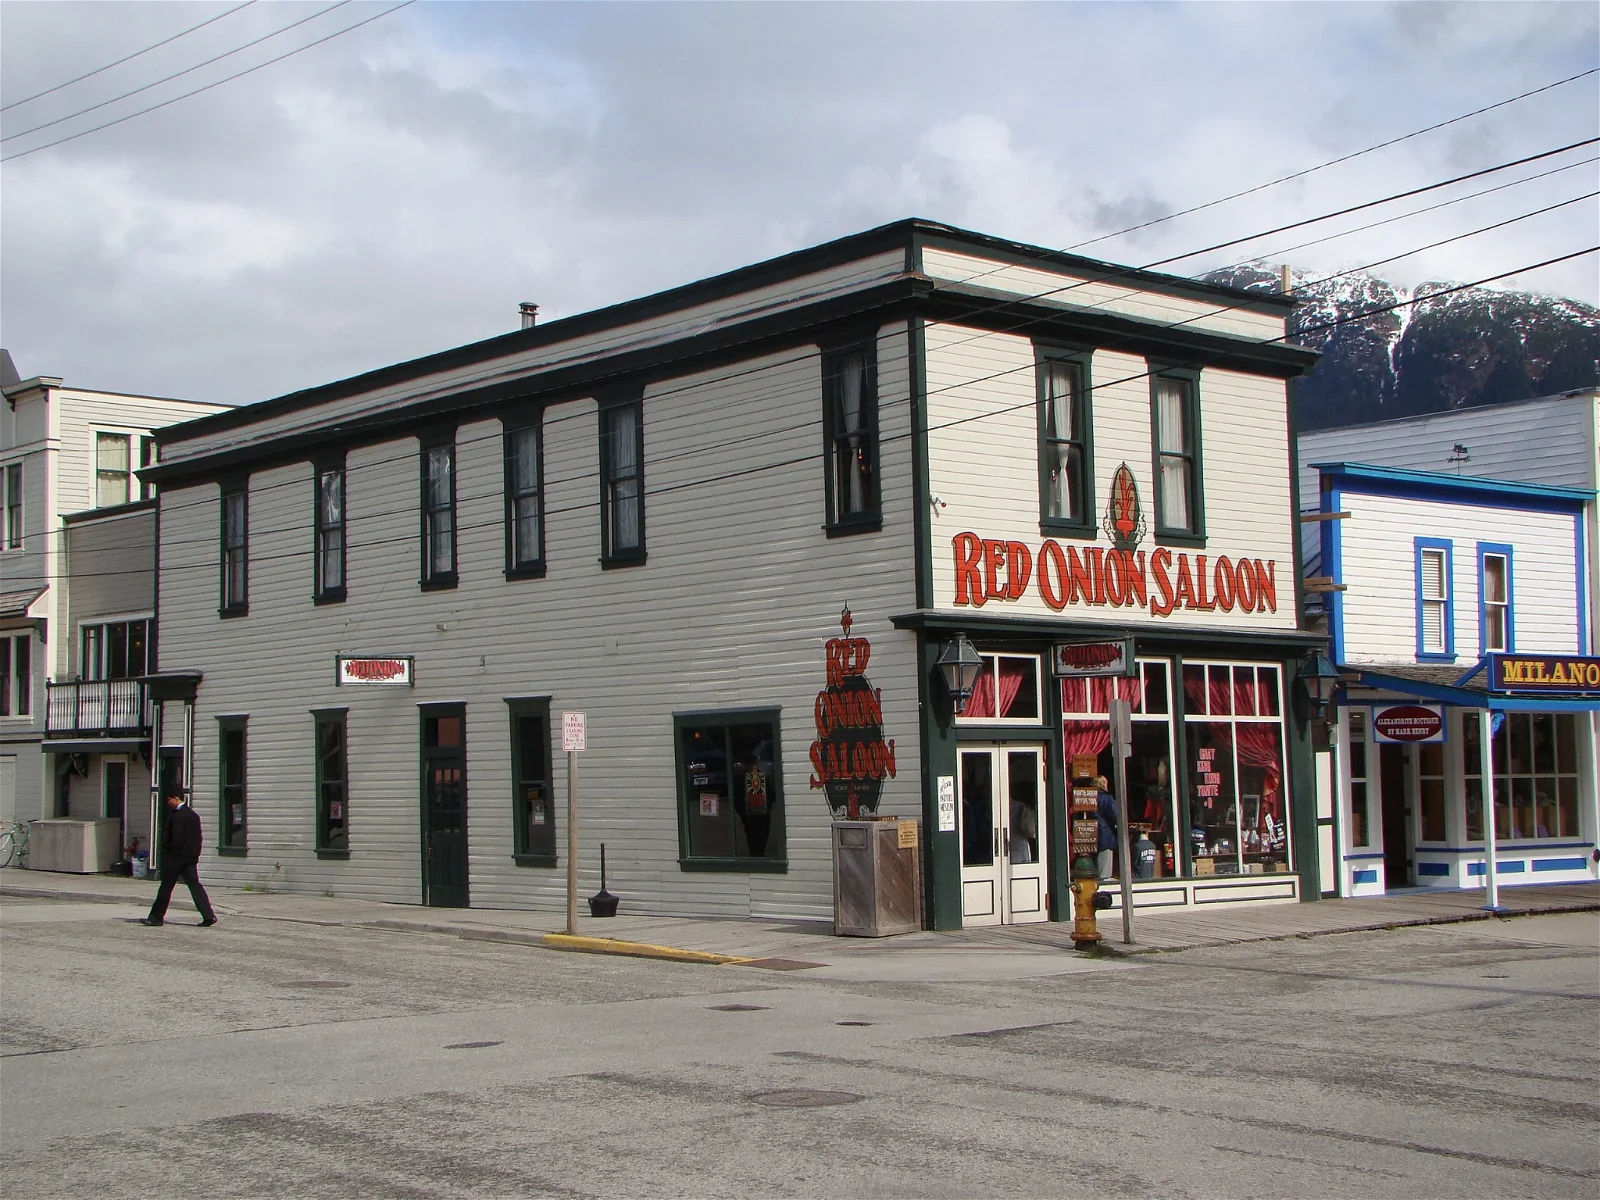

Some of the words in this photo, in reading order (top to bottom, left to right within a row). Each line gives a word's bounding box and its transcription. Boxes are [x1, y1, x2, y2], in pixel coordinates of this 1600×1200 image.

[953, 532, 1033, 608] RED
[1037, 539, 1147, 613] ONION
[1150, 547, 1276, 618] SALOON
[825, 638, 870, 687] RED
[1502, 660, 1600, 687] MILANO
[815, 688, 882, 738] ONION
[809, 739, 896, 789] SALOON
